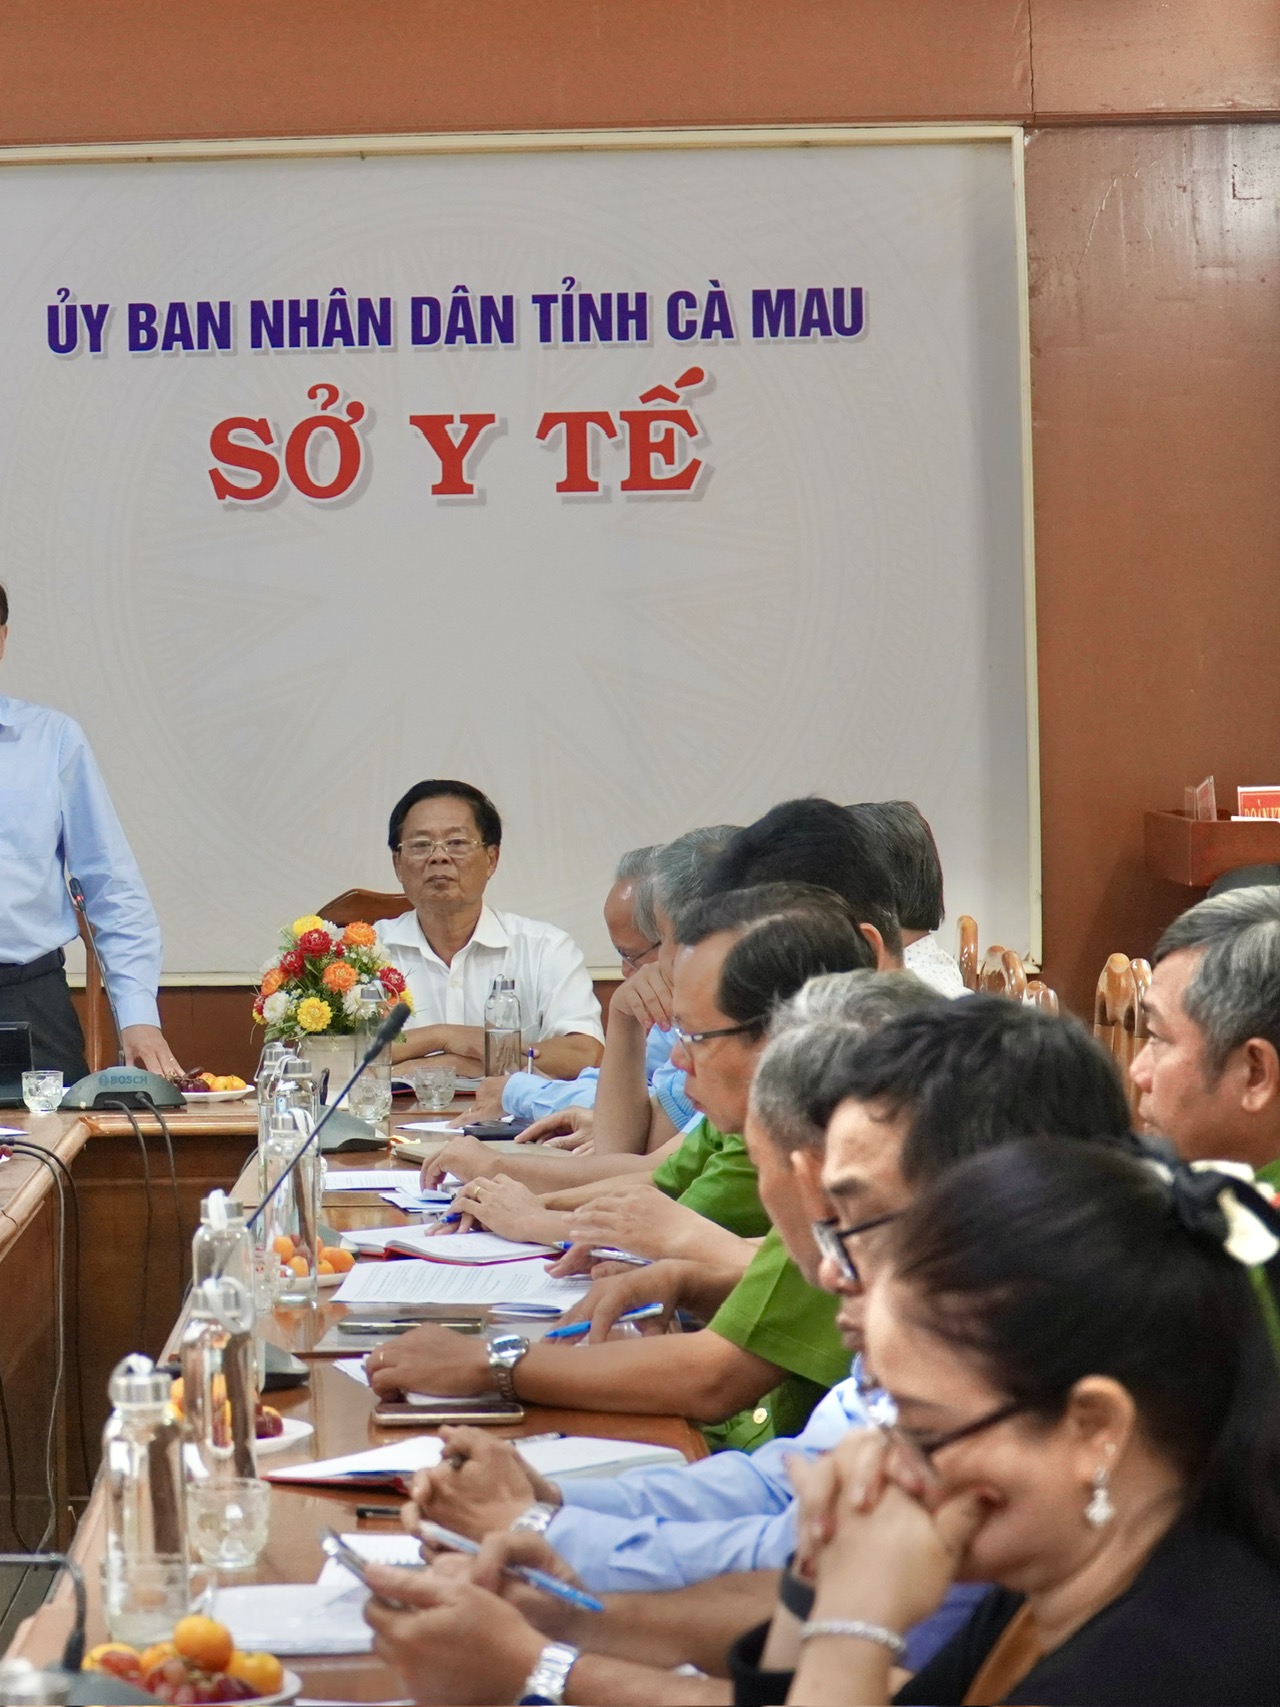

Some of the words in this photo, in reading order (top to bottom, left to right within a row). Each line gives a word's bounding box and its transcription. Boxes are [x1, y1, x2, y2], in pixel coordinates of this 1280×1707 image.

[46, 287, 110, 354] ỦY
[127, 300, 231, 352] BAN
[250, 287, 392, 349] NHÂN
[410, 284, 514, 346] DÂN
[531, 276, 648, 343] TỈNH
[666, 279, 735, 341] CÀ
[752, 287, 863, 339] MAU
[208, 383, 365, 501] SỞ
[409, 413, 496, 495] Y
[536, 366, 705, 493] TẾ
[110, 1075, 148, 1085] BOSCH
